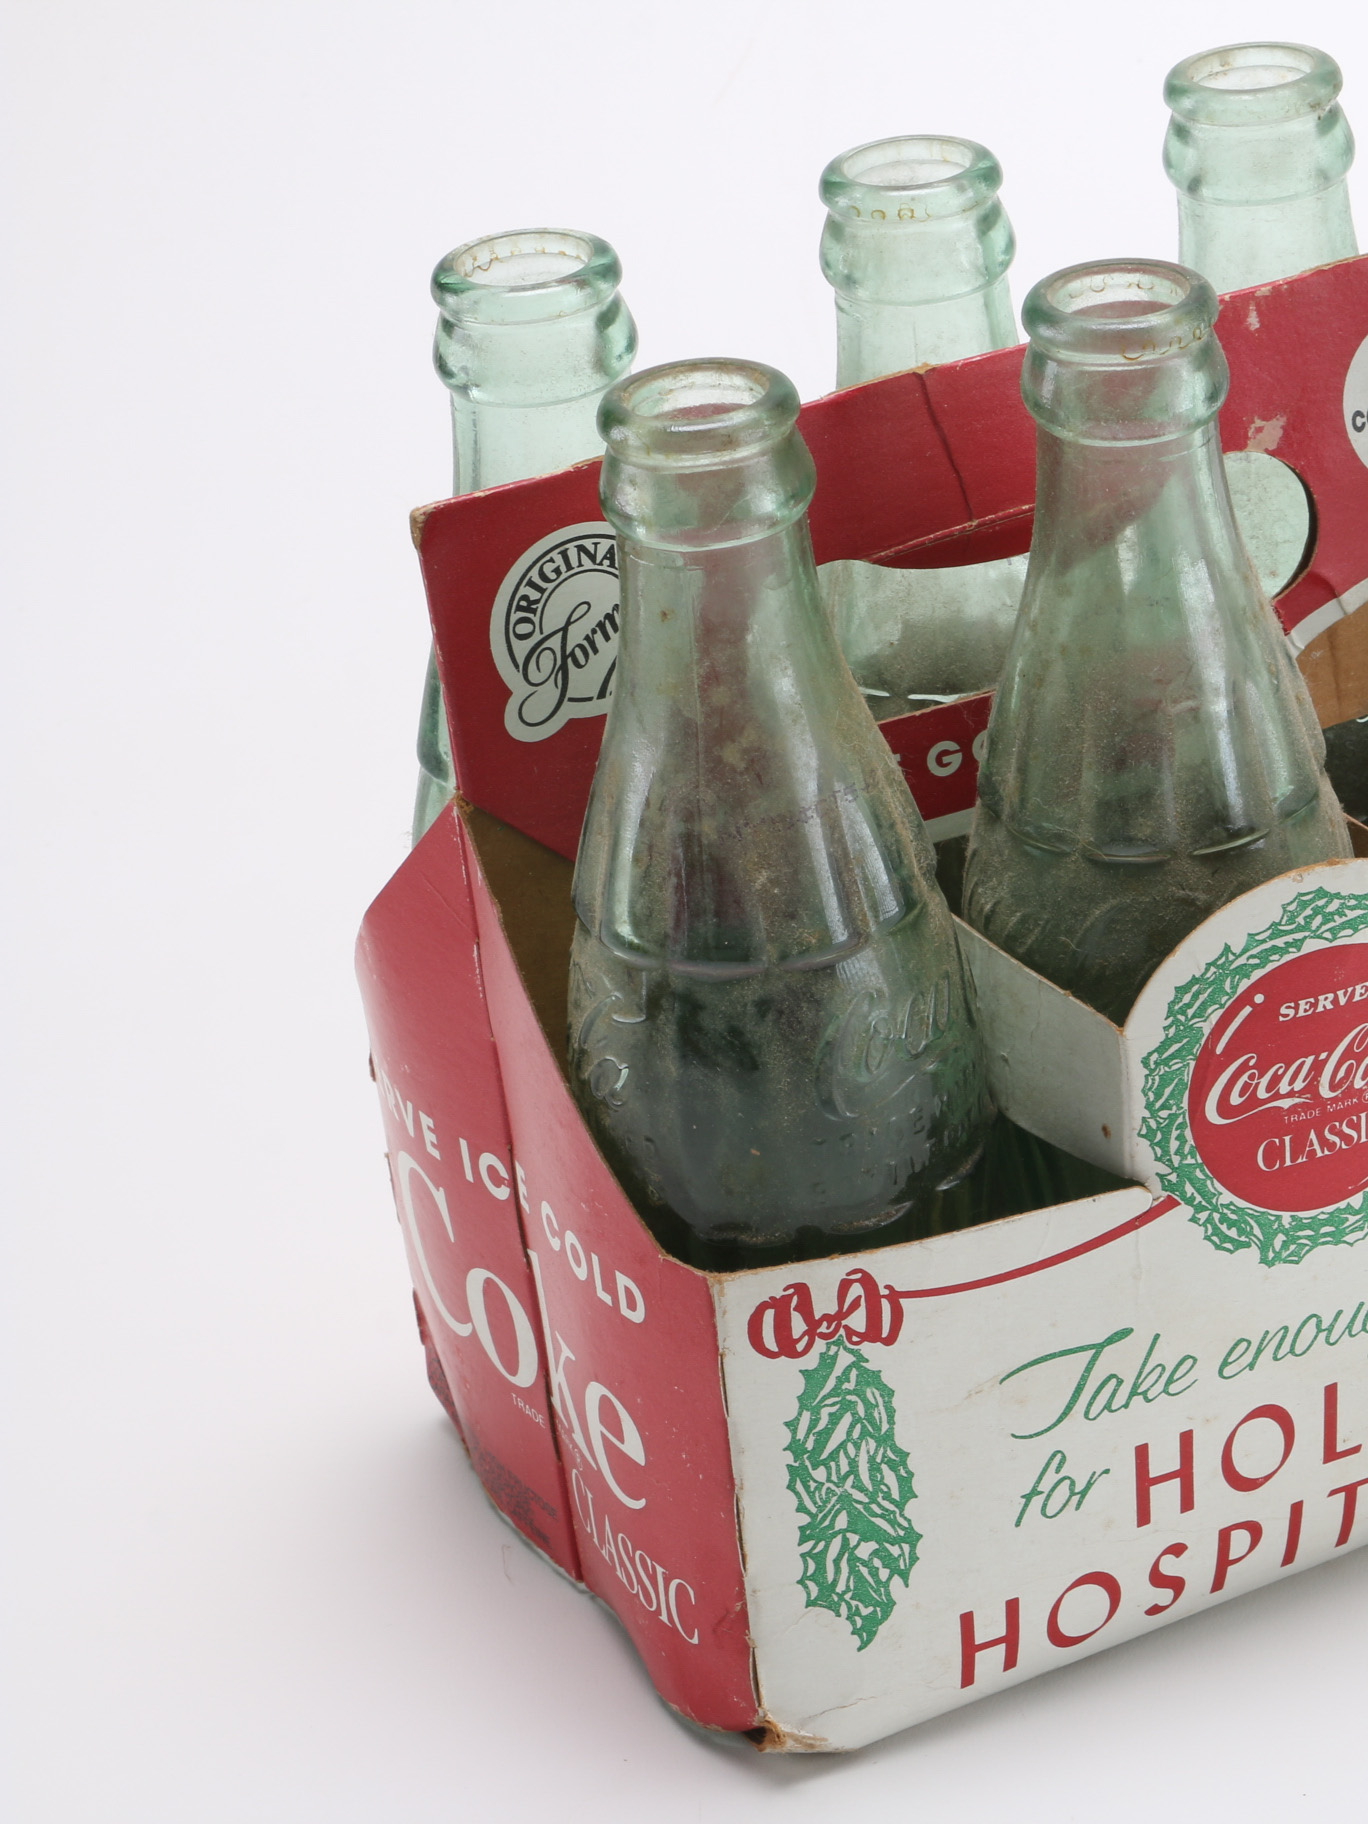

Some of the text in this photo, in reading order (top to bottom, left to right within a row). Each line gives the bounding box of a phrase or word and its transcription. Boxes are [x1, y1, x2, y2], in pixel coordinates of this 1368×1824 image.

[513, 542, 619, 641] ORIGINA
[1284, 1108, 1321, 1124] TRADE
[377, 1066, 646, 1324] RVE ICE COLD
[398, 1151, 646, 1510] Coke
[999, 1327, 1199, 1439] Take
[511, 1393, 546, 1430] TRADE
[1014, 1450, 1110, 1527] for
[571, 1468, 699, 1645] CLASSIC
